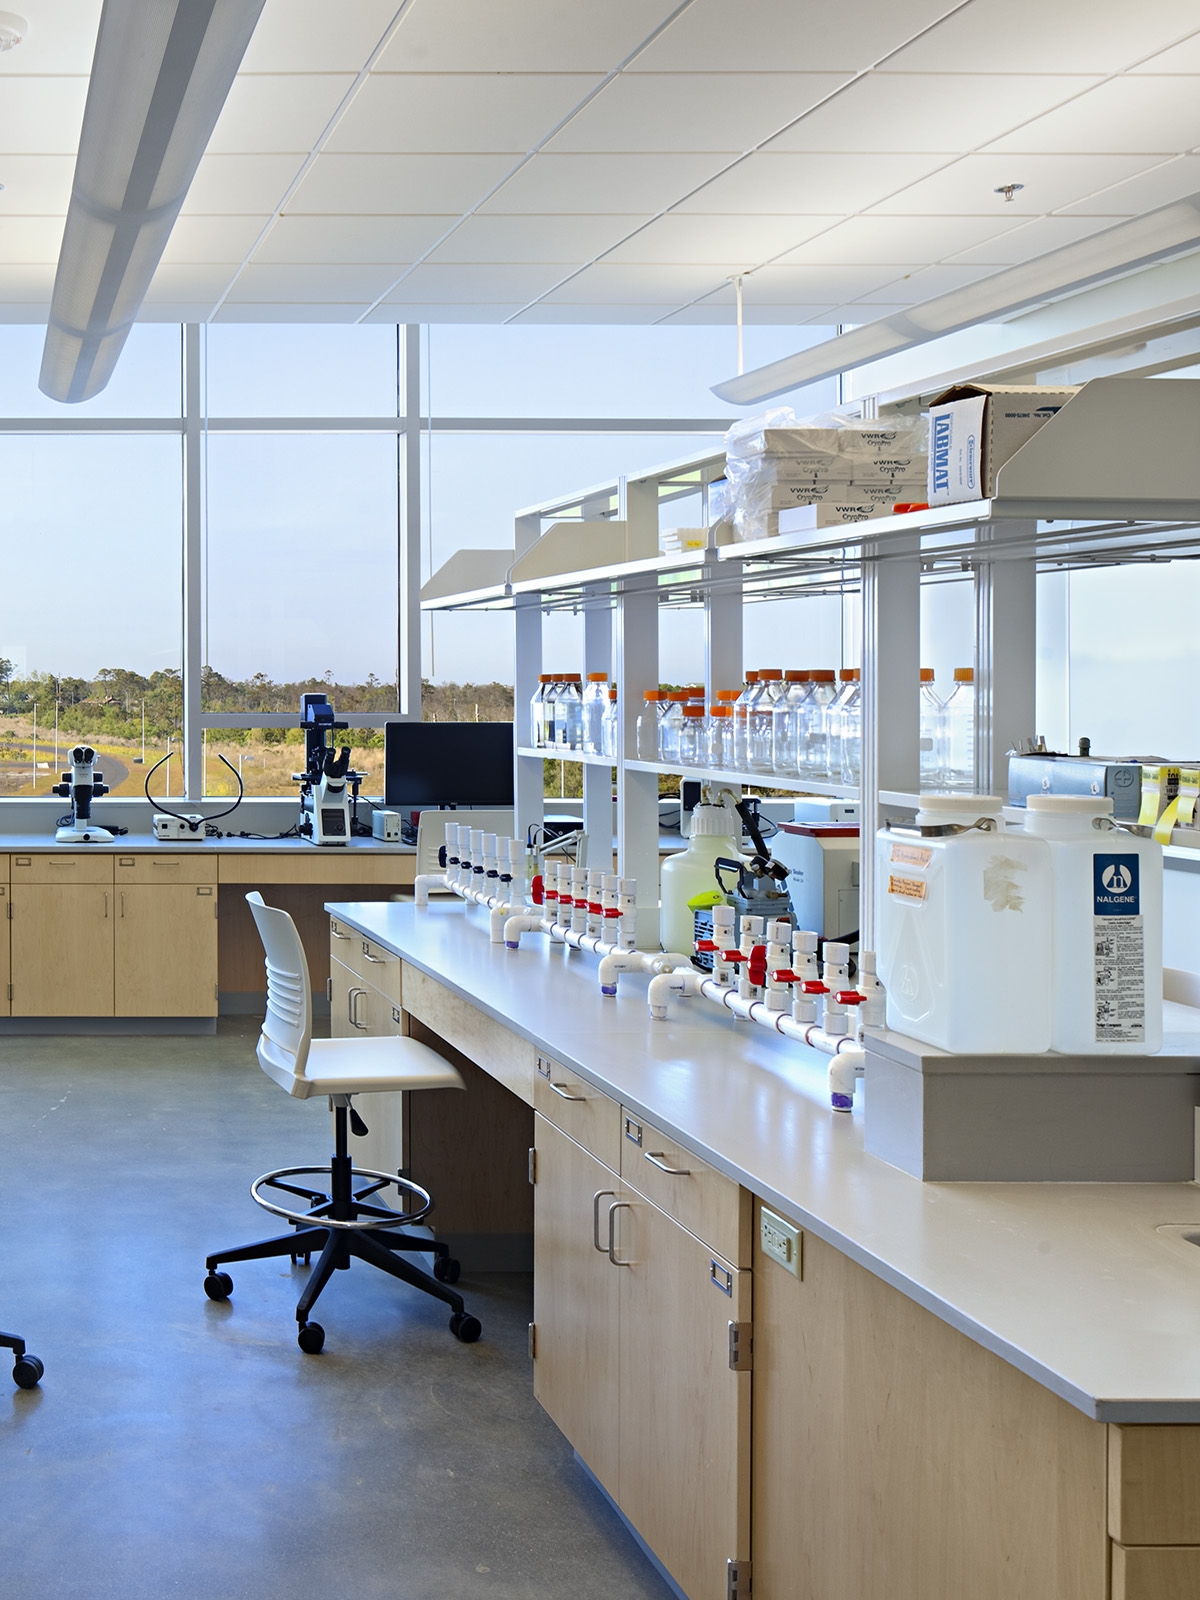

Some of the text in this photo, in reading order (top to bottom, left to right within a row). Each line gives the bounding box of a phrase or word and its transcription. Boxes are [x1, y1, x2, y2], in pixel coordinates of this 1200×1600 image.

[935, 413, 951, 491] LABMAT
[879, 466, 906, 474] CryoPro
[842, 513, 869, 521] CryoPro
